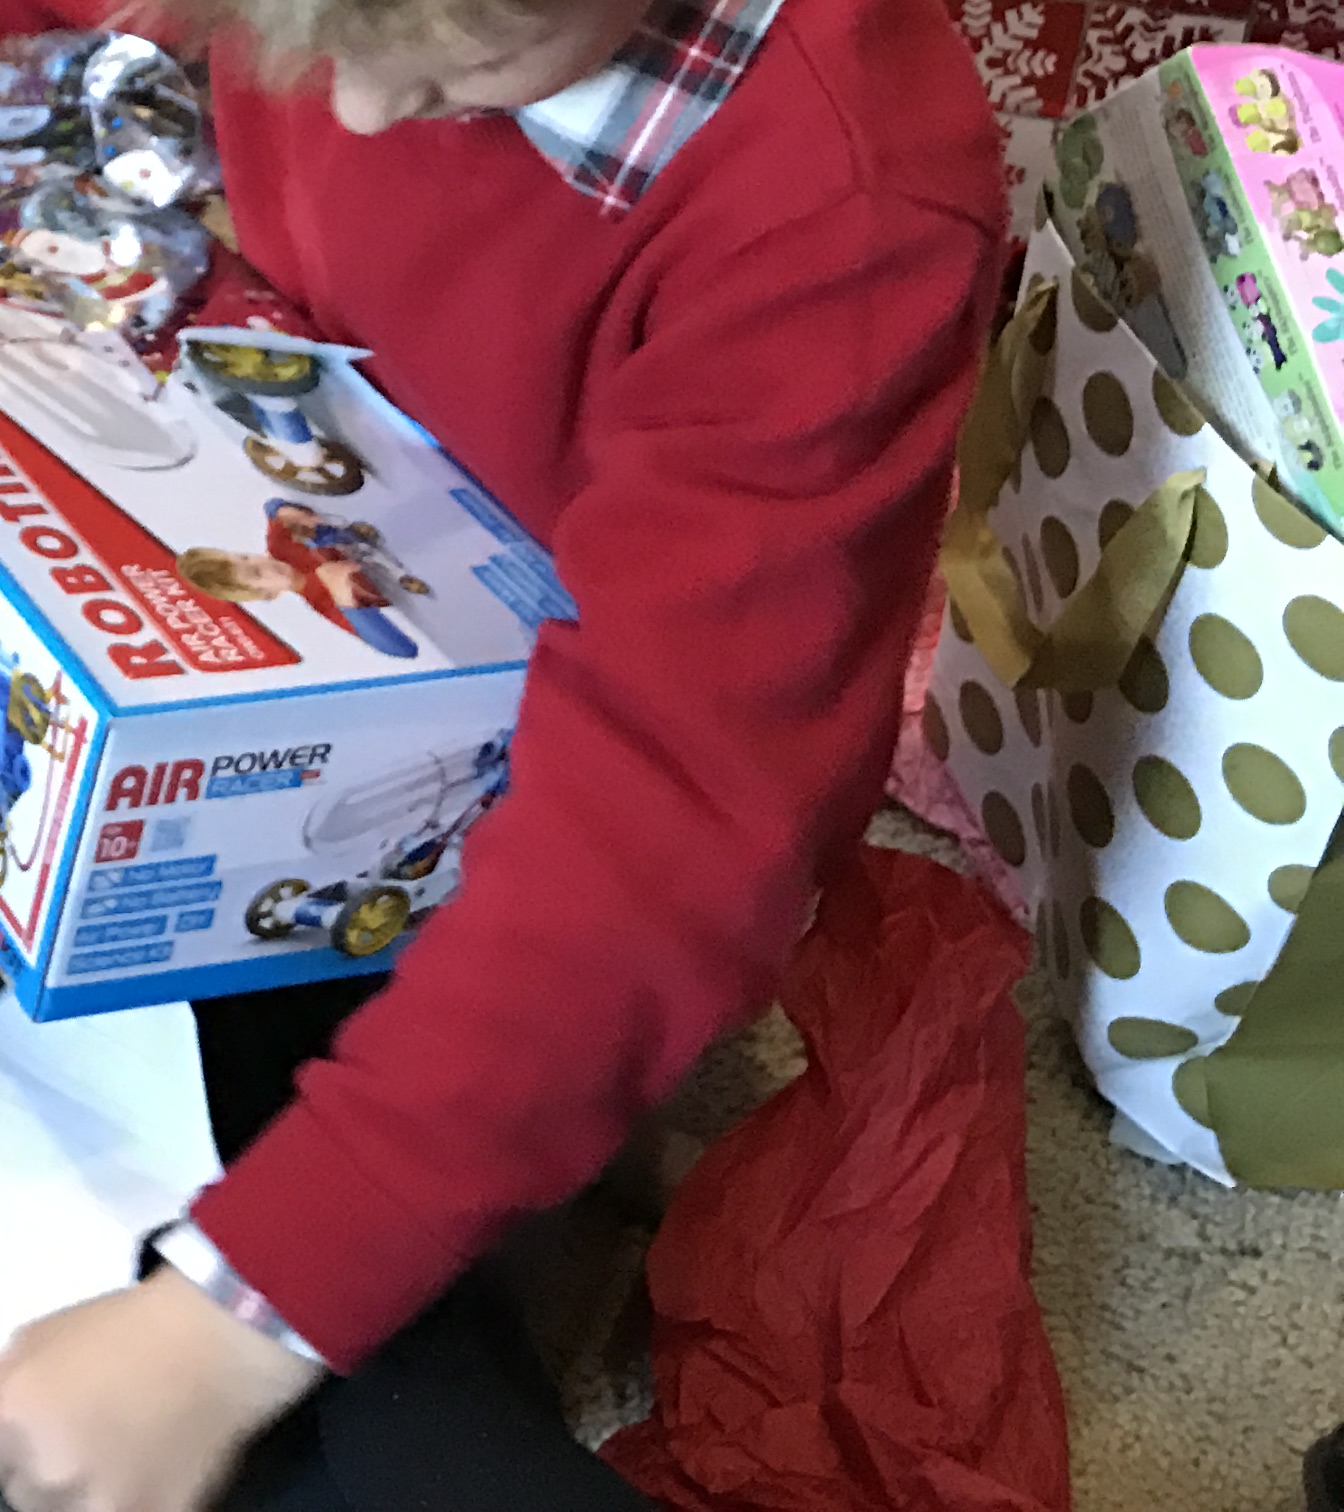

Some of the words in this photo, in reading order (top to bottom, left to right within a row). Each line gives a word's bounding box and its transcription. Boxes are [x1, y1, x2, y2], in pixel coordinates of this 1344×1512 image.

[121, 564, 192, 630] POWER
[146, 568, 188, 596] KIT
[176, 599, 246, 662] RACER
[181, 633, 222, 663] AIR
[105, 758, 205, 811] AIR
[211, 743, 333, 777] POWER
